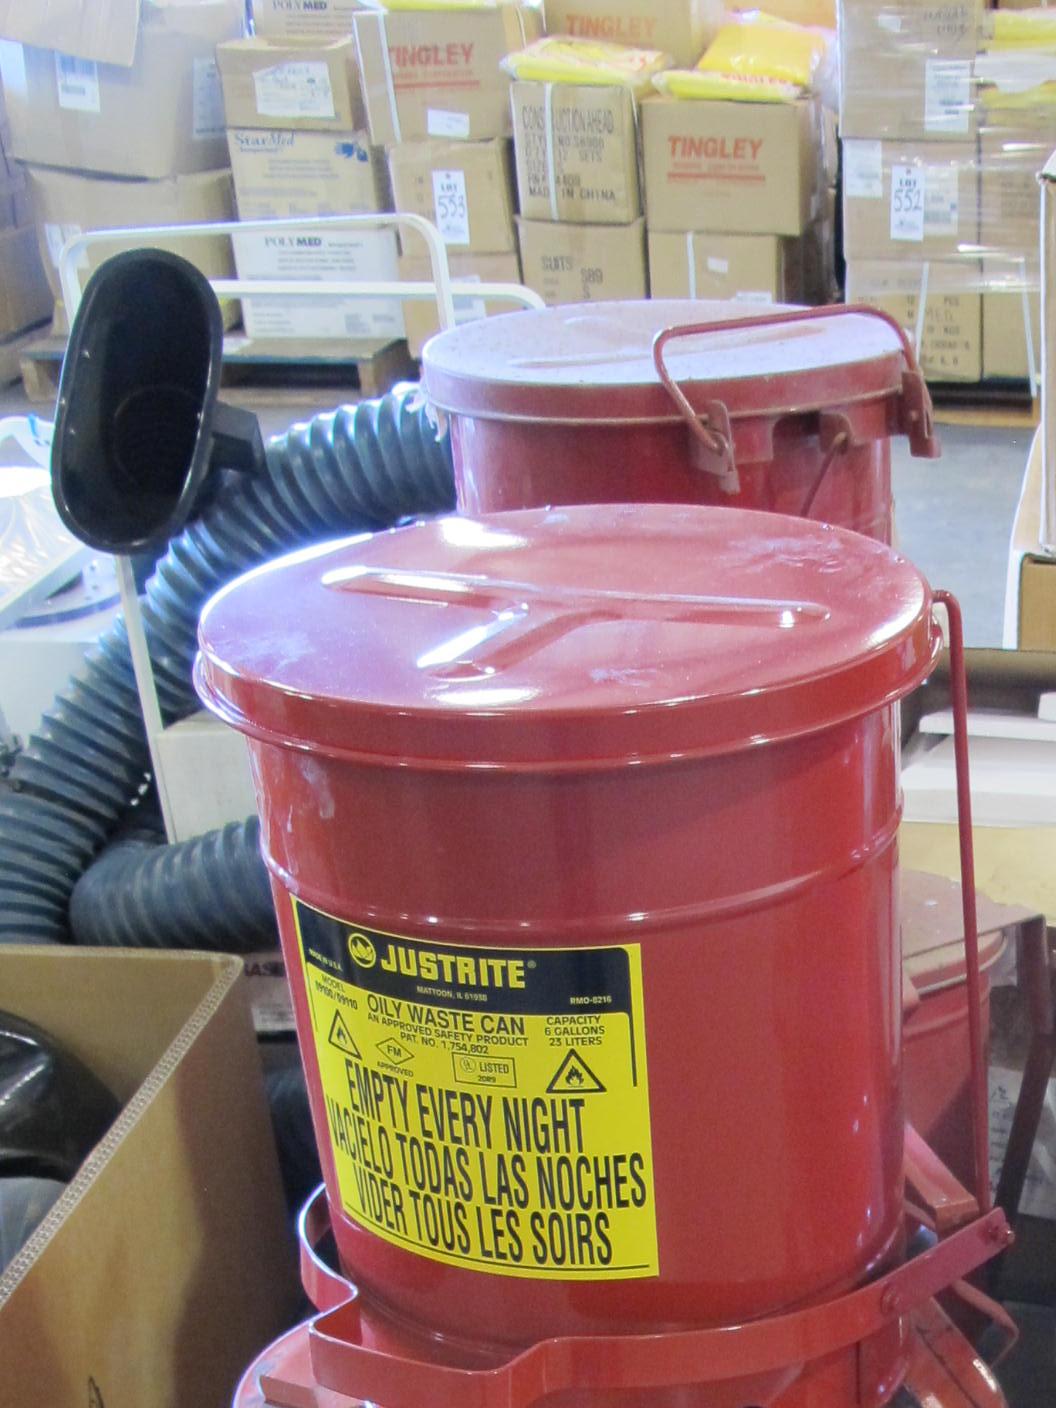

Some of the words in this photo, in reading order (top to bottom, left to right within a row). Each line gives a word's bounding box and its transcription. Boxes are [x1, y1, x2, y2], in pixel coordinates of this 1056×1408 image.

[565, 15, 656, 37] TINGLEY
[668, 135, 763, 161] TINGLEY
[264, 236, 322, 248] POLYMED
[381, 944, 526, 990] JUSTRITE
[367, 993, 402, 1019] OILY
[406, 1002, 475, 1033] WASTE
[480, 1014, 526, 1036] CAN
[546, 1015, 601, 1026] CAPACITY
[367, 1012, 380, 1025] AN
[381, 1016, 432, 1037] APPROVED
[434, 1028, 473, 1042] SAFETY
[476, 1035, 529, 1047] PRODUCT
[544, 1026, 551, 1036] 6
[554, 1025, 605, 1036] GALLONS
[549, 1037, 562, 1047] 23
[565, 1036, 603, 1047] LITERS
[377, 1060, 414, 1078] APPROVED
[480, 1062, 510, 1074] LISTED
[345, 1058, 409, 1133] EMPTY
[415, 1082, 494, 1150] EVERY
[502, 1096, 586, 1154] NIGHT
[326, 1094, 394, 1180] VACIELO
[396, 1132, 474, 1203] TODAS
[478, 1151, 530, 1210] LAS
[536, 1152, 646, 1211] NOCHES
[353, 1164, 407, 1235] VIDER
[409, 1189, 471, 1255] TOUS
[475, 1205, 524, 1261] LES
[532, 1210, 614, 1265] SOIRS
